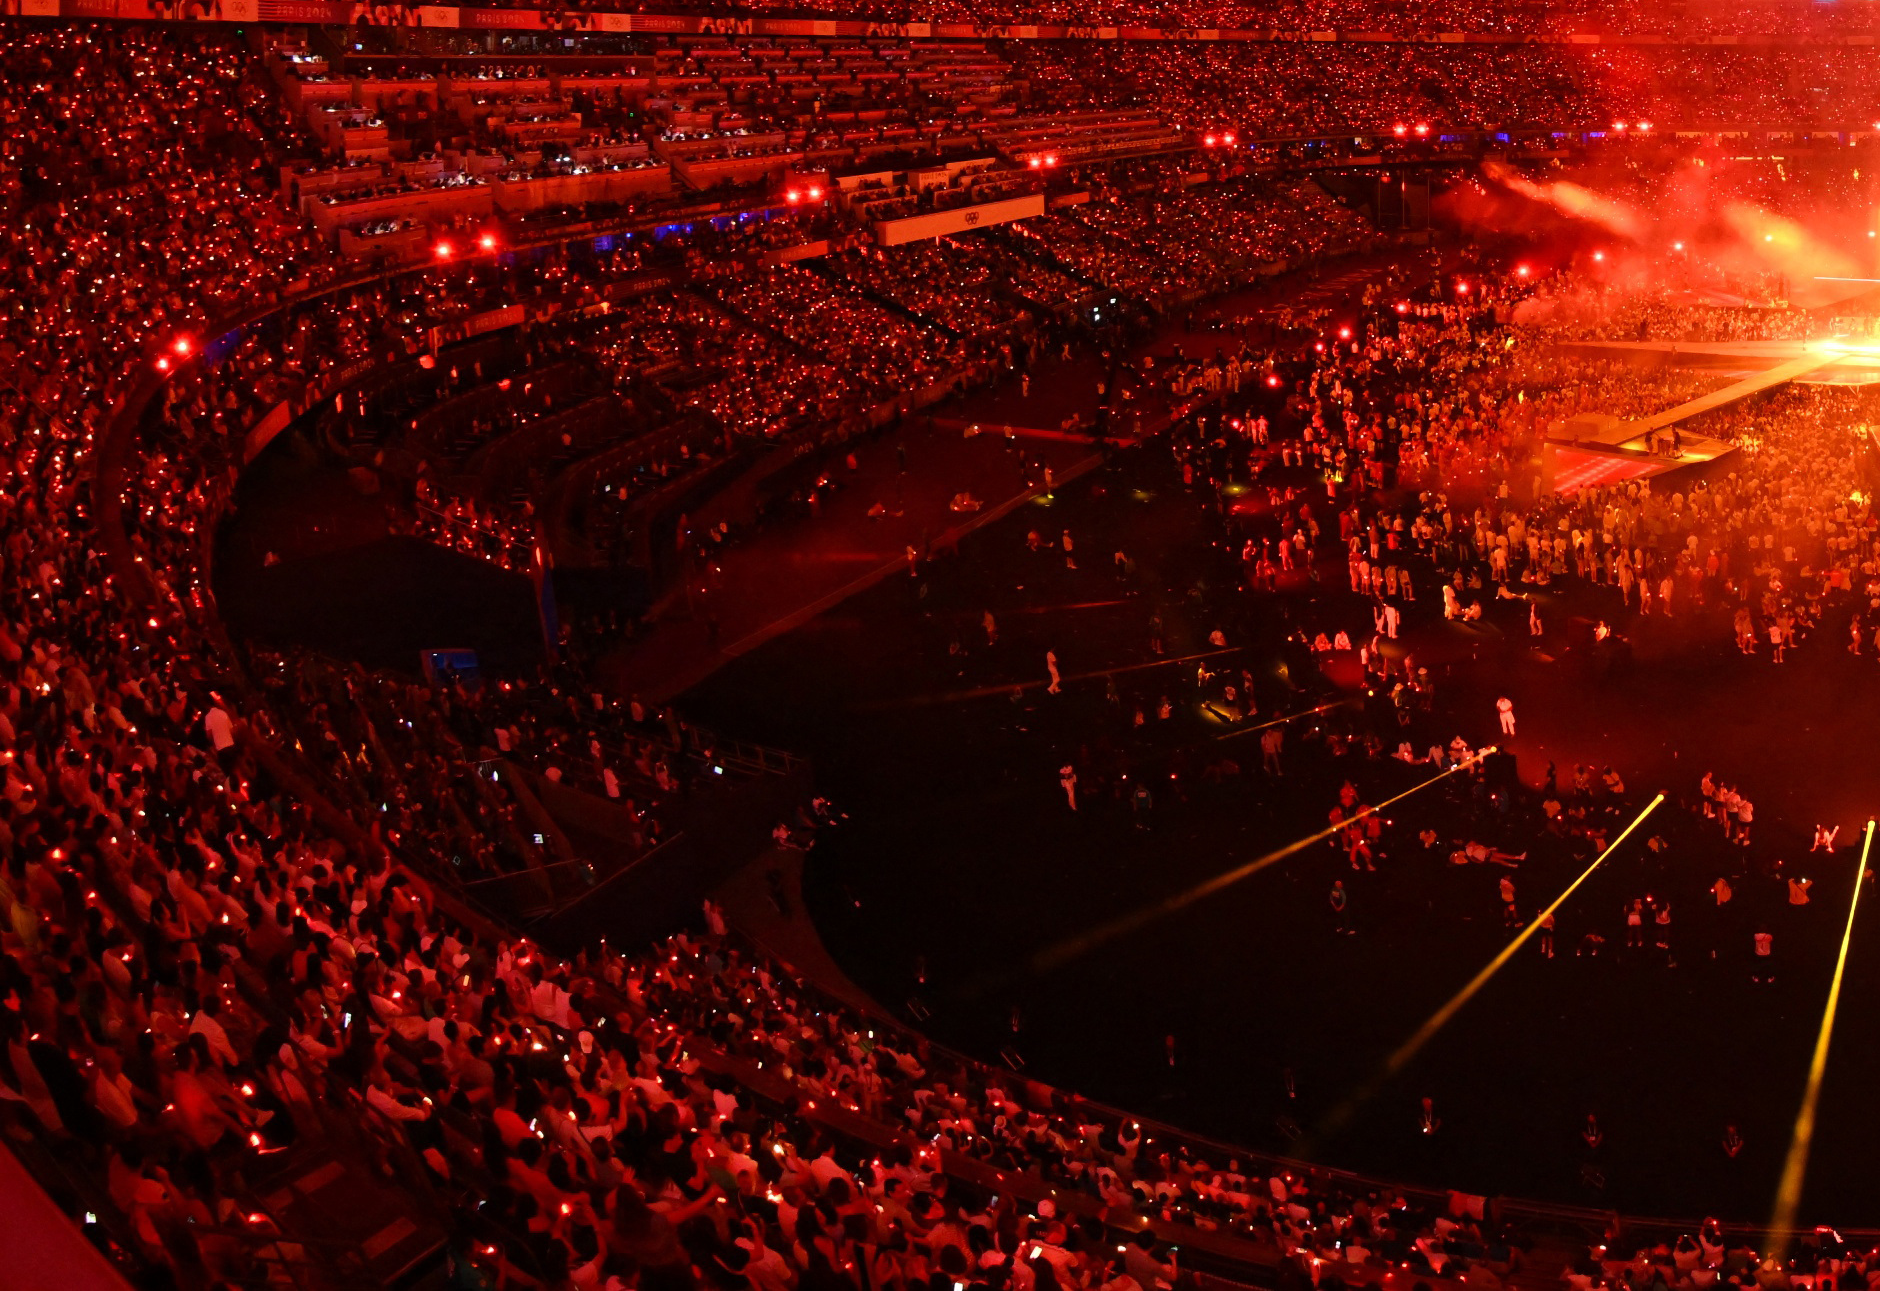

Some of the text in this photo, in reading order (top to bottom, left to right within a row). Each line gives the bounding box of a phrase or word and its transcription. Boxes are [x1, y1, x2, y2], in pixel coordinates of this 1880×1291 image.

[276, 5, 332, 18] PARIS 2024
[476, 13, 501, 24] PARIS
[645, 19, 686, 29] PARIS 2024
